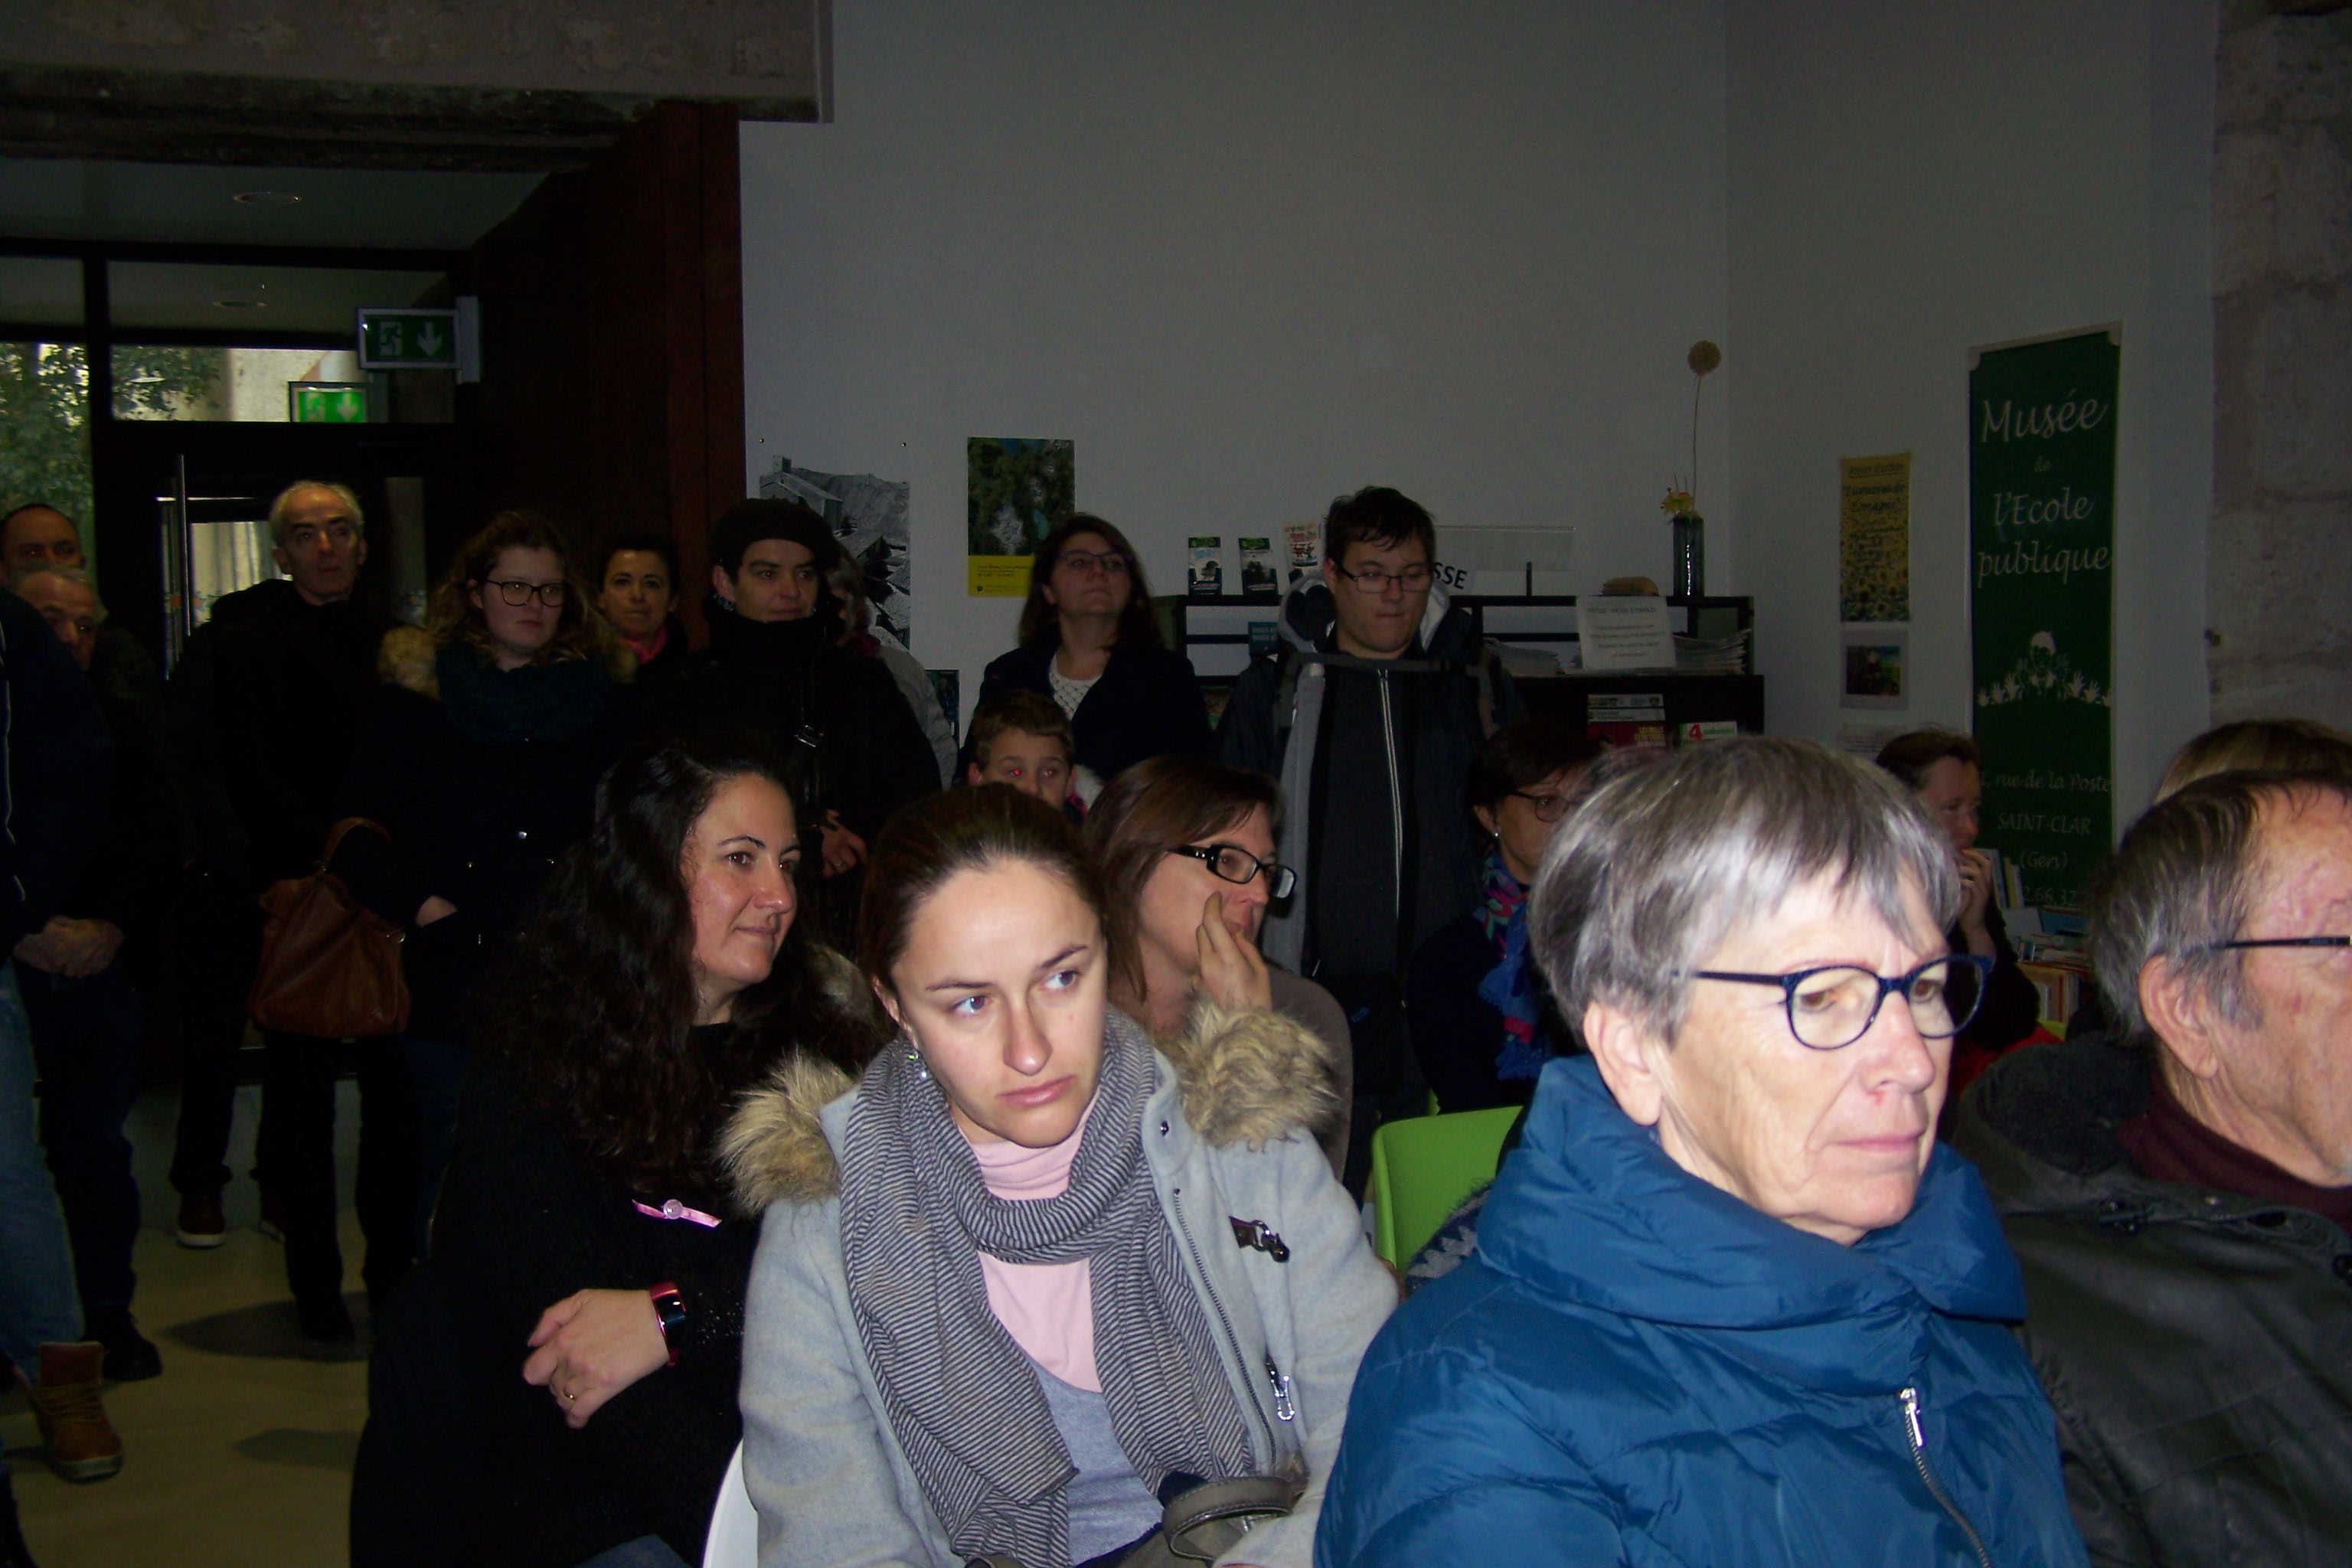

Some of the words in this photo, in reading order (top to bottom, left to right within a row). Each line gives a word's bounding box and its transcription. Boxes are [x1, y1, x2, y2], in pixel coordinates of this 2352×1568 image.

[1981, 388, 2109, 443] Musée
[2034, 456, 2052, 473] de
[1993, 485, 2096, 527] l'Ecole
[1433, 561, 1468, 590] SSE
[1977, 539, 2112, 590] publique
[1688, 723, 1704, 740] 4
[1994, 773, 2020, 788] rue
[2024, 769, 2044, 789] de
[2047, 770, 2065, 789] la
[2069, 773, 2112, 792] Poste
[2020, 848, 2069, 871] (Gers)
